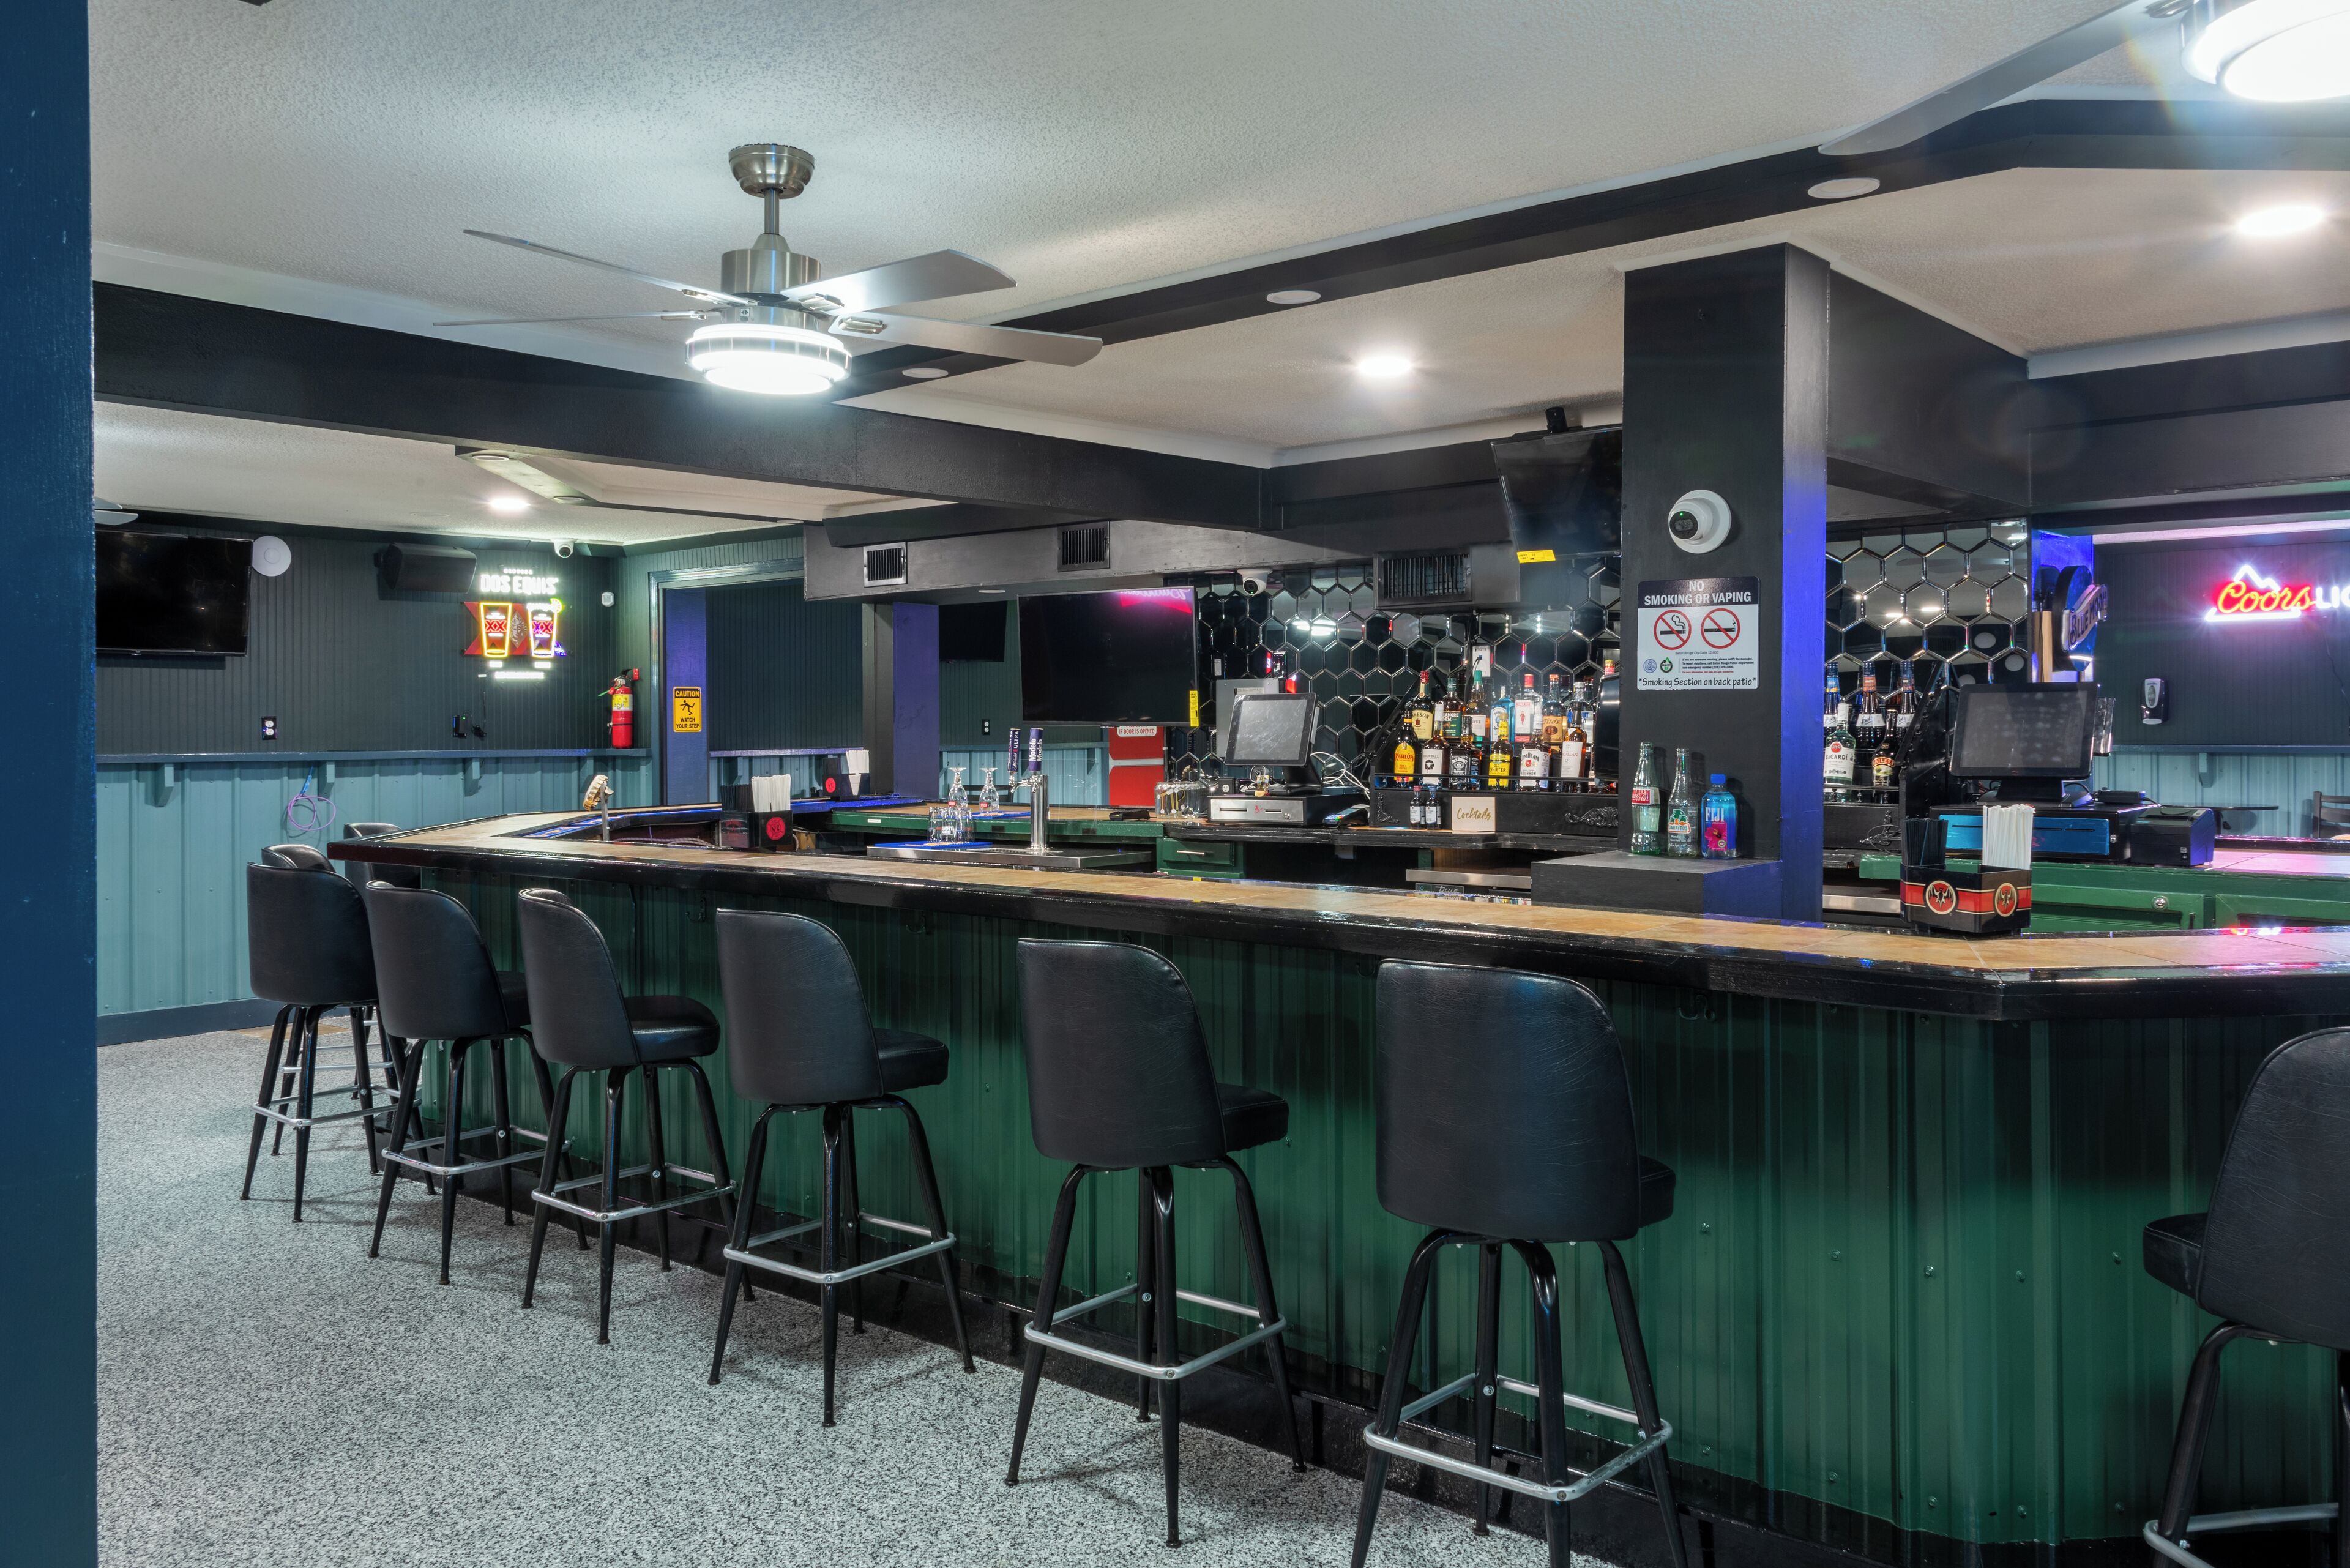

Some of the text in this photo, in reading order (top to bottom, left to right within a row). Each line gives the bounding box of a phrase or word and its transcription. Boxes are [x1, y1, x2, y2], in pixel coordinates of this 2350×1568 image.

[480, 574, 556, 595] DOS EQUIS
[1689, 581, 1704, 592] NO
[1644, 592, 1751, 605] SMOKING OR VAPING
[2217, 581, 2312, 614] Coors
[2070, 610, 2088, 645] BLUE
[1674, 678, 1702, 686] Section
[1528, 752, 1539, 761] BEAM
[1457, 807, 1492, 821] Cocktails
[1705, 807, 1725, 822] FIJI
